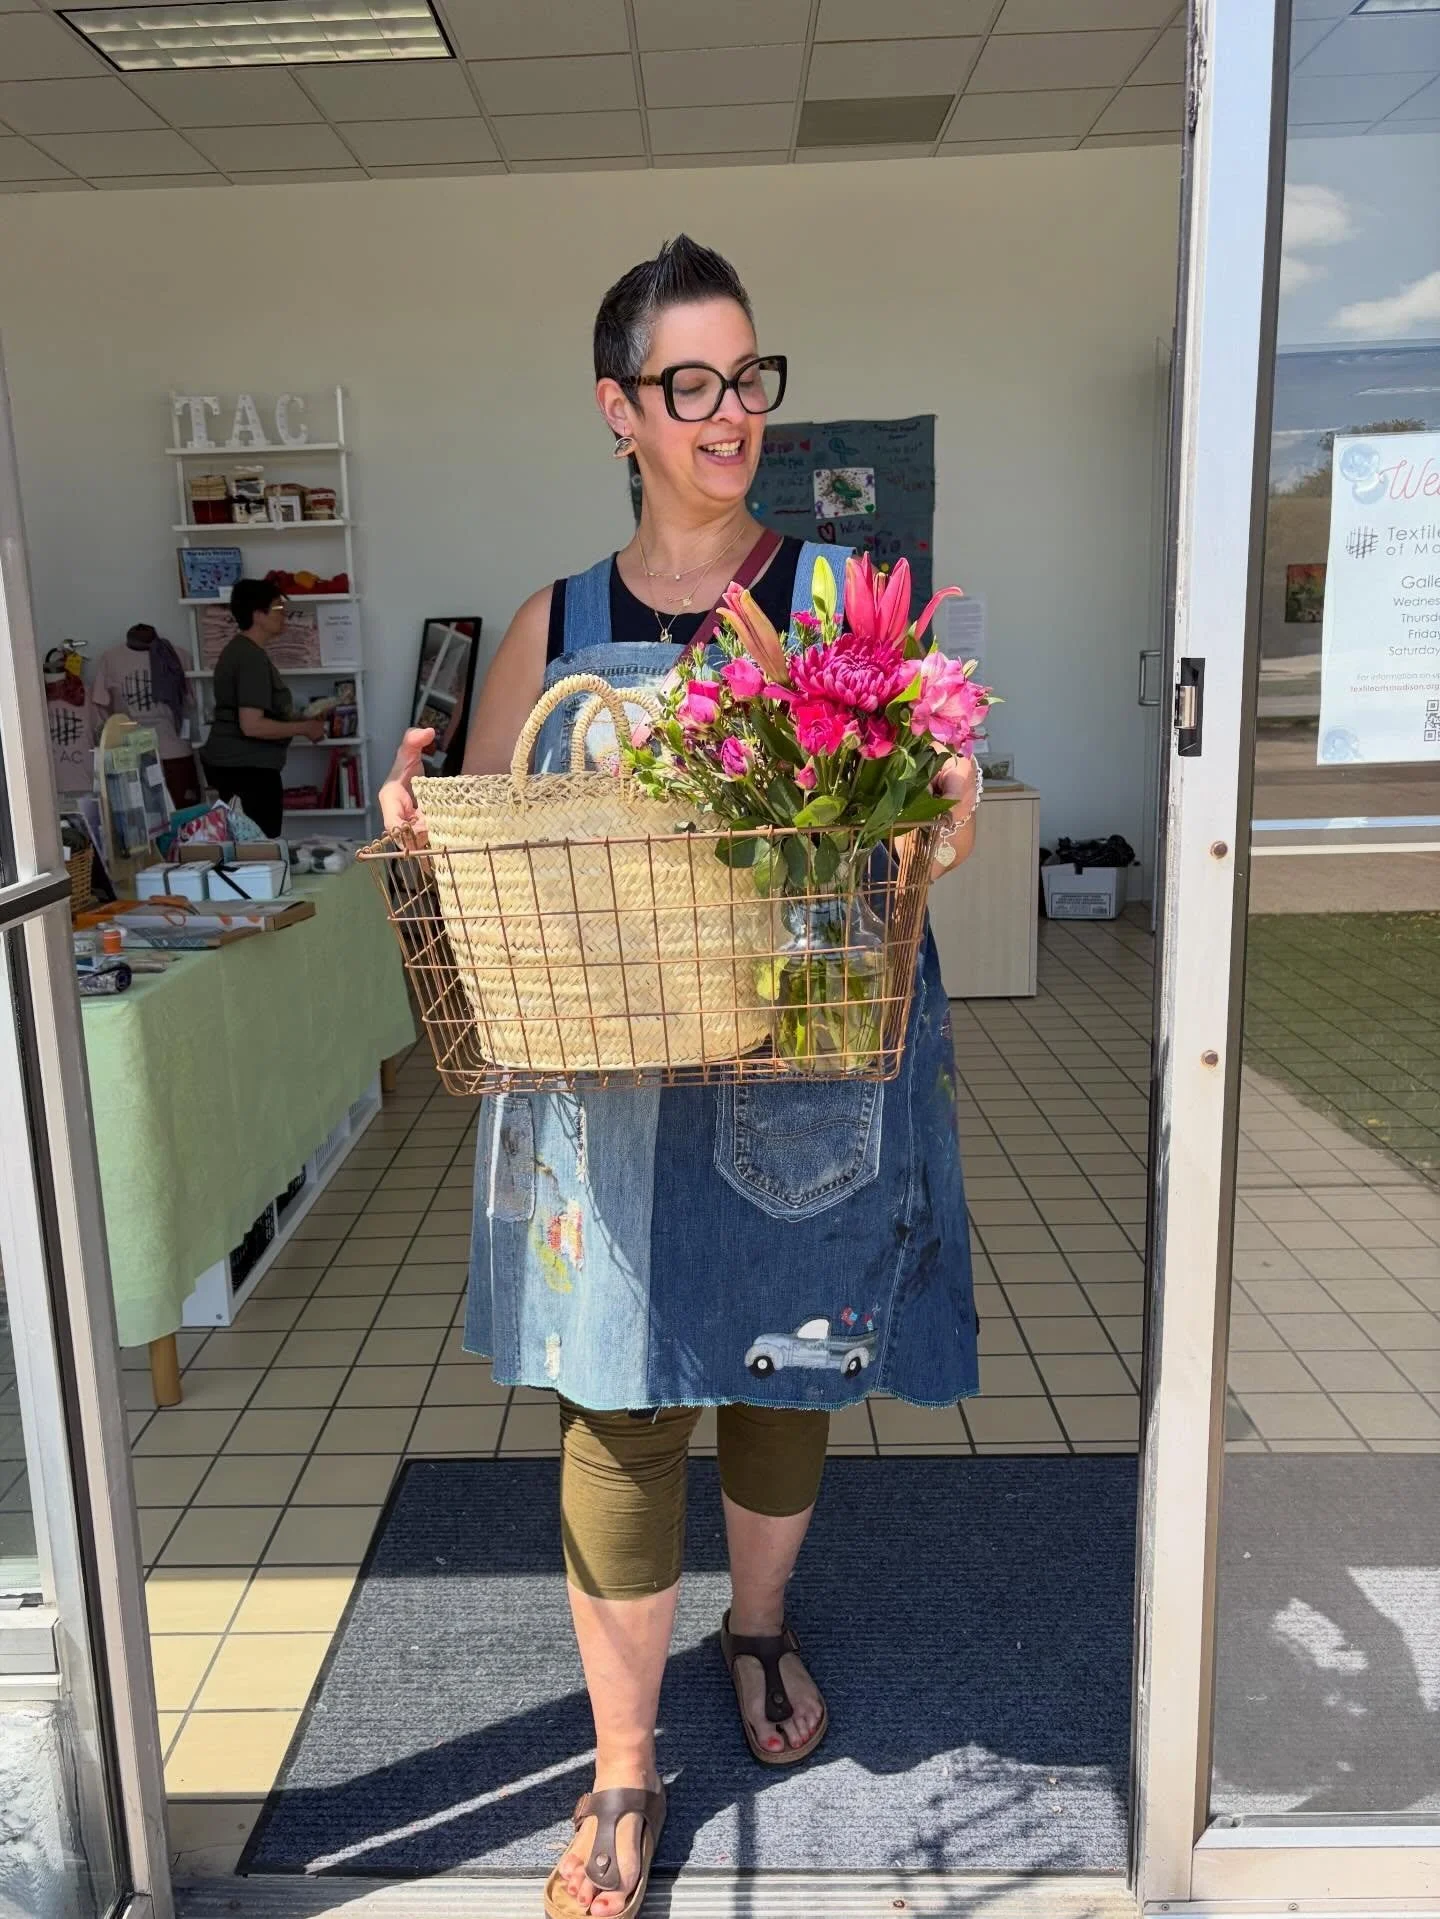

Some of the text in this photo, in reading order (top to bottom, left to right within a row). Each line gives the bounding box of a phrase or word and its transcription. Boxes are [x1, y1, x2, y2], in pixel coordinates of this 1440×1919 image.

[174, 394, 309, 449] TAC
[1379, 457, 1440, 500] We
[1387, 523, 1440, 541] Textil
[1386, 543, 1404, 556] of
[1389, 645, 1440, 657] Saturday
[1369, 672, 1418, 681] information
